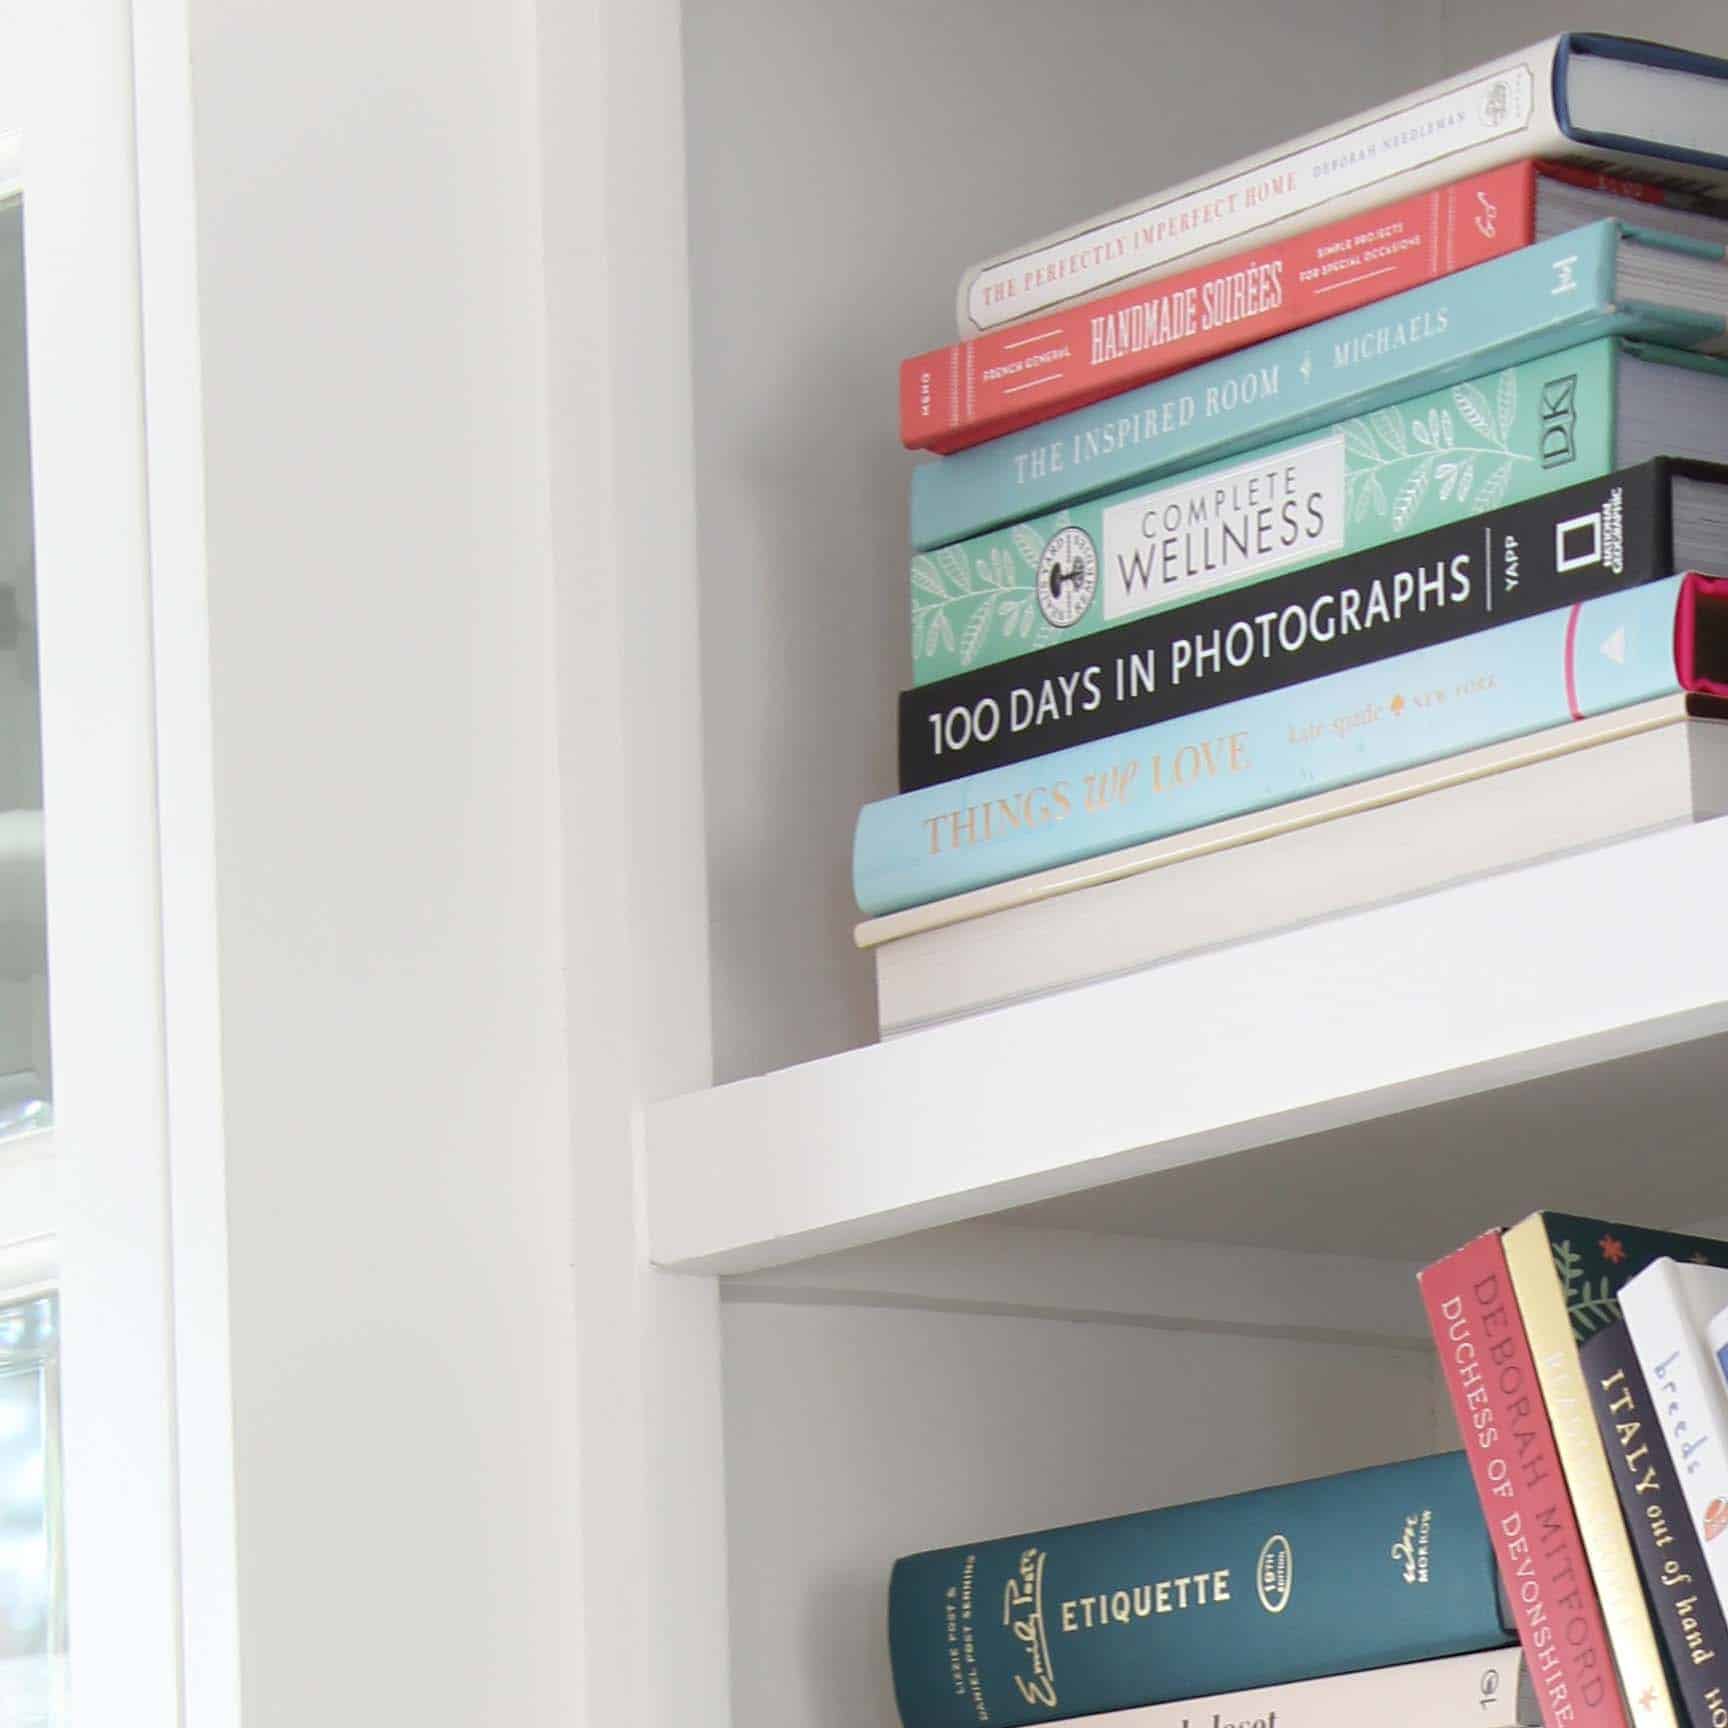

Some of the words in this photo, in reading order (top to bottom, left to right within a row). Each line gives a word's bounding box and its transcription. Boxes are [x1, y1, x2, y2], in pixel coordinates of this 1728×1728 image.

[982, 278, 1017, 306] THE
[1024, 236, 1128, 292] PERFECTLY
[1133, 191, 1238, 252] IMPERFECT
[1245, 171, 1298, 208] HOME
[1090, 287, 1197, 367] HANDMADE
[1202, 260, 1284, 331] SOIRÉES
[1014, 432, 1064, 485] THE
[1072, 383, 1194, 464] INSPIRED
[1206, 369, 1281, 415] ROOM
[1332, 307, 1450, 369] MICHAELS
[1118, 491, 1325, 596] WELLNESS
[1141, 466, 1297, 539] COMPLETE
[1504, 535, 1520, 592] YAPP
[928, 698, 1000, 755] 100
[1010, 666, 1101, 733] DAYS
[1115, 650, 1156, 702] IN
[1170, 554, 1471, 685] PHOTOGRAPHS
[922, 779, 1073, 855] THINGS
[1152, 730, 1250, 793] LOVE
[1441, 1295, 1499, 1449] DUCHESS
[1487, 1459, 1514, 1498] OF
[1600, 1368, 1659, 1494] ITALY
[1654, 1351, 1709, 1475] breeds
[1418, 1509, 1432, 1582] MORROW
[1472, 1274, 1549, 1487] DEBORAH
[1535, 1504, 1607, 1710] MITFORD
[1646, 1505, 1675, 1547] out
[1062, 1568, 1231, 1634] ETIQUETTE
[1662, 1561, 1692, 1585] of
[1675, 1596, 1714, 1665] hand
